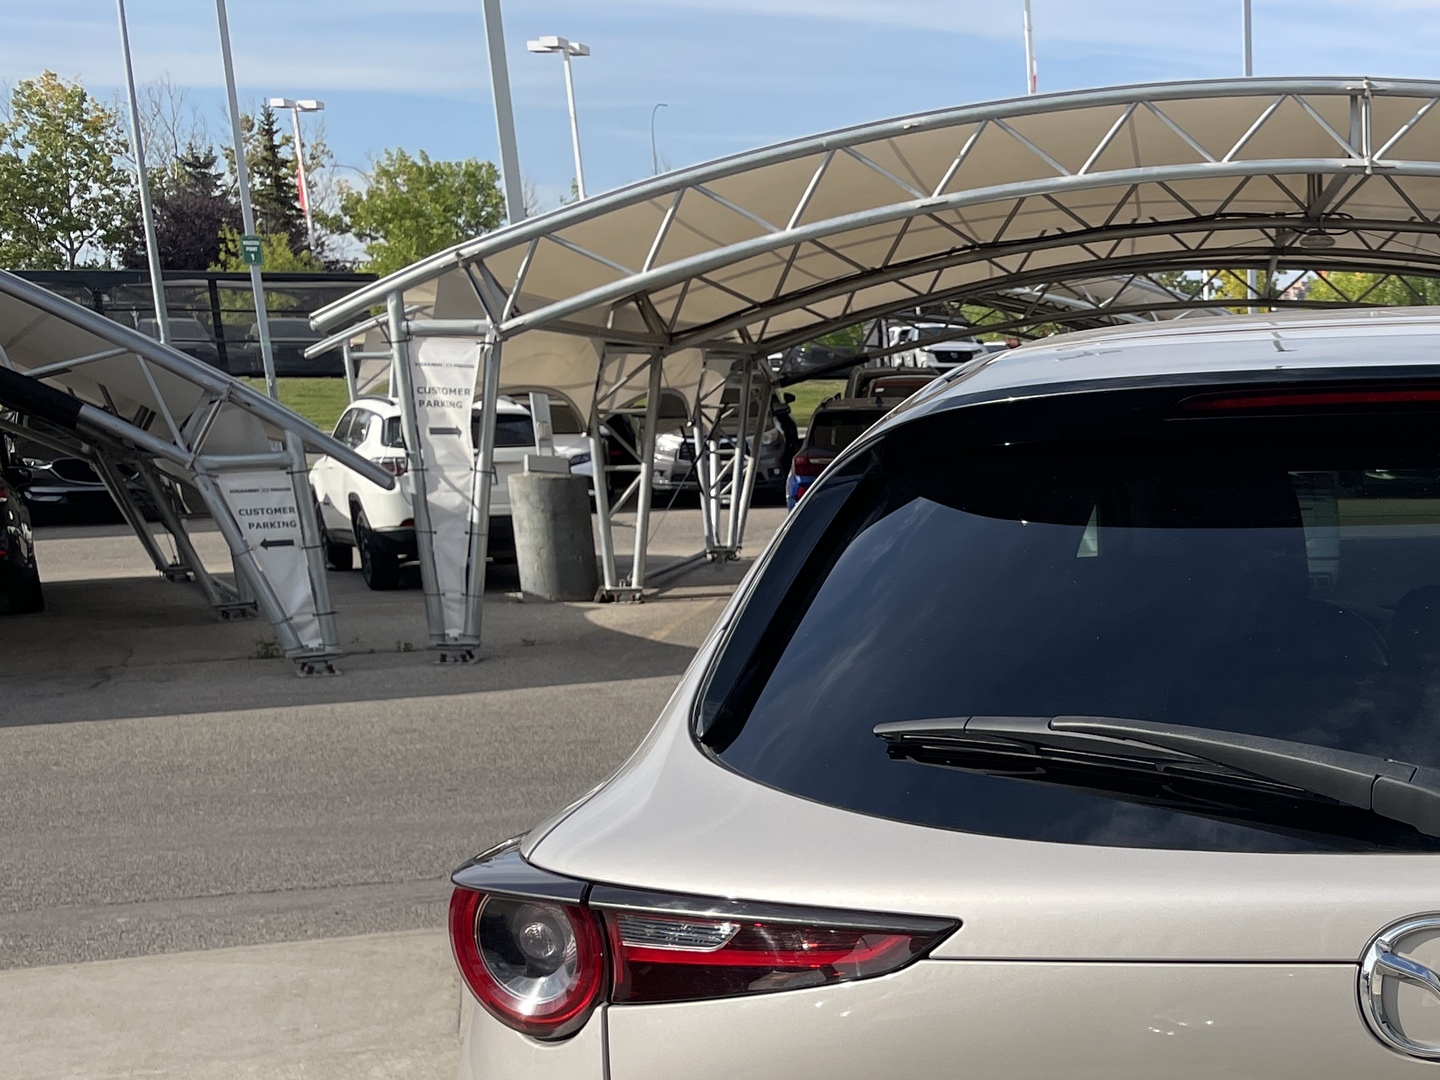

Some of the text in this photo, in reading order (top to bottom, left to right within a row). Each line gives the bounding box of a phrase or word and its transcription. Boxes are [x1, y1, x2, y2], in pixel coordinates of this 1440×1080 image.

[416, 386, 471, 396] CUSTOMER
[418, 399, 463, 409] PARKING
[238, 506, 296, 516] CUSTOMER
[248, 520, 297, 530] PARKING
